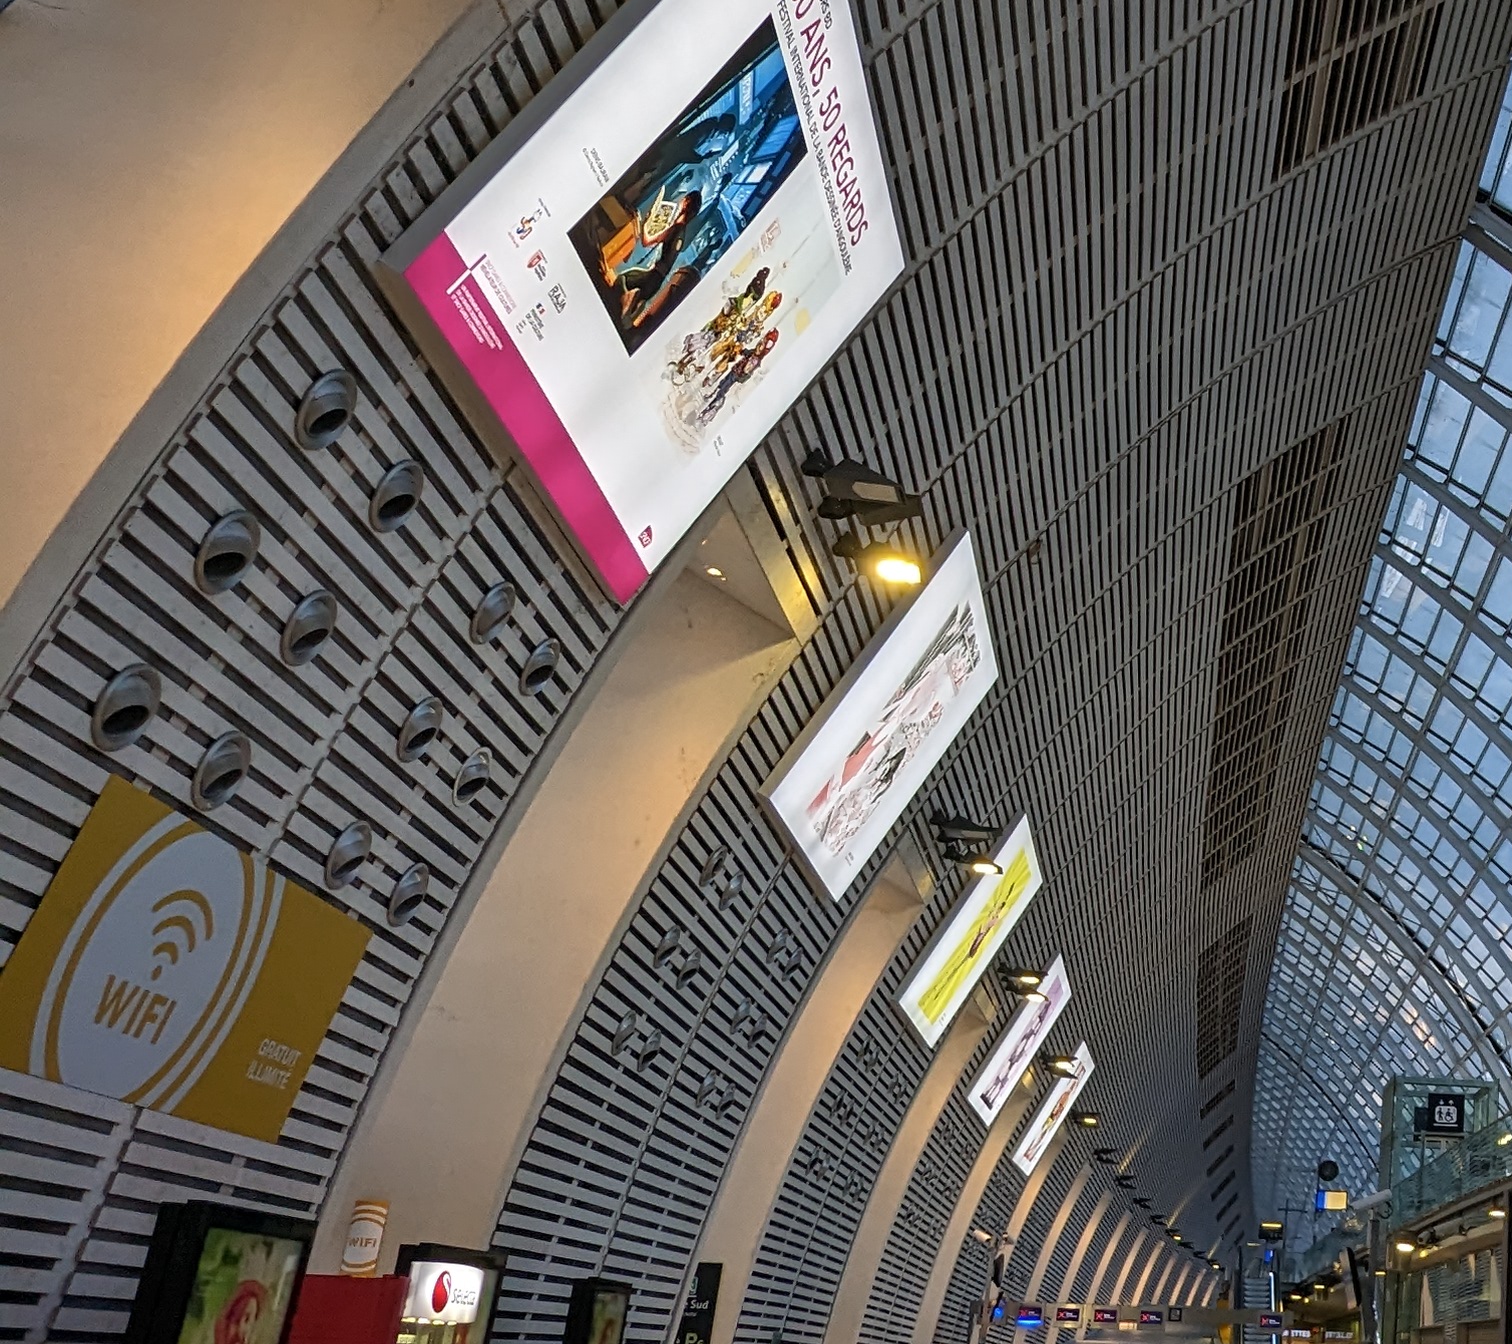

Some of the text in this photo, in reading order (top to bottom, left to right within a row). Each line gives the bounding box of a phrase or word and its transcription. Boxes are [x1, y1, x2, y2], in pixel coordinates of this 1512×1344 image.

[800, 20, 832, 97] ANS,
[788, 48, 815, 128] INTERNATIONAL
[820, 87, 842, 133] 50
[828, 122, 869, 248] REGARDS
[93, 974, 178, 1045] WIFI
[246, 1060, 292, 1090] ILLIMITÉ
[258, 1038, 302, 1067] GRATUIT
[690, 1299, 709, 1310] Sud
